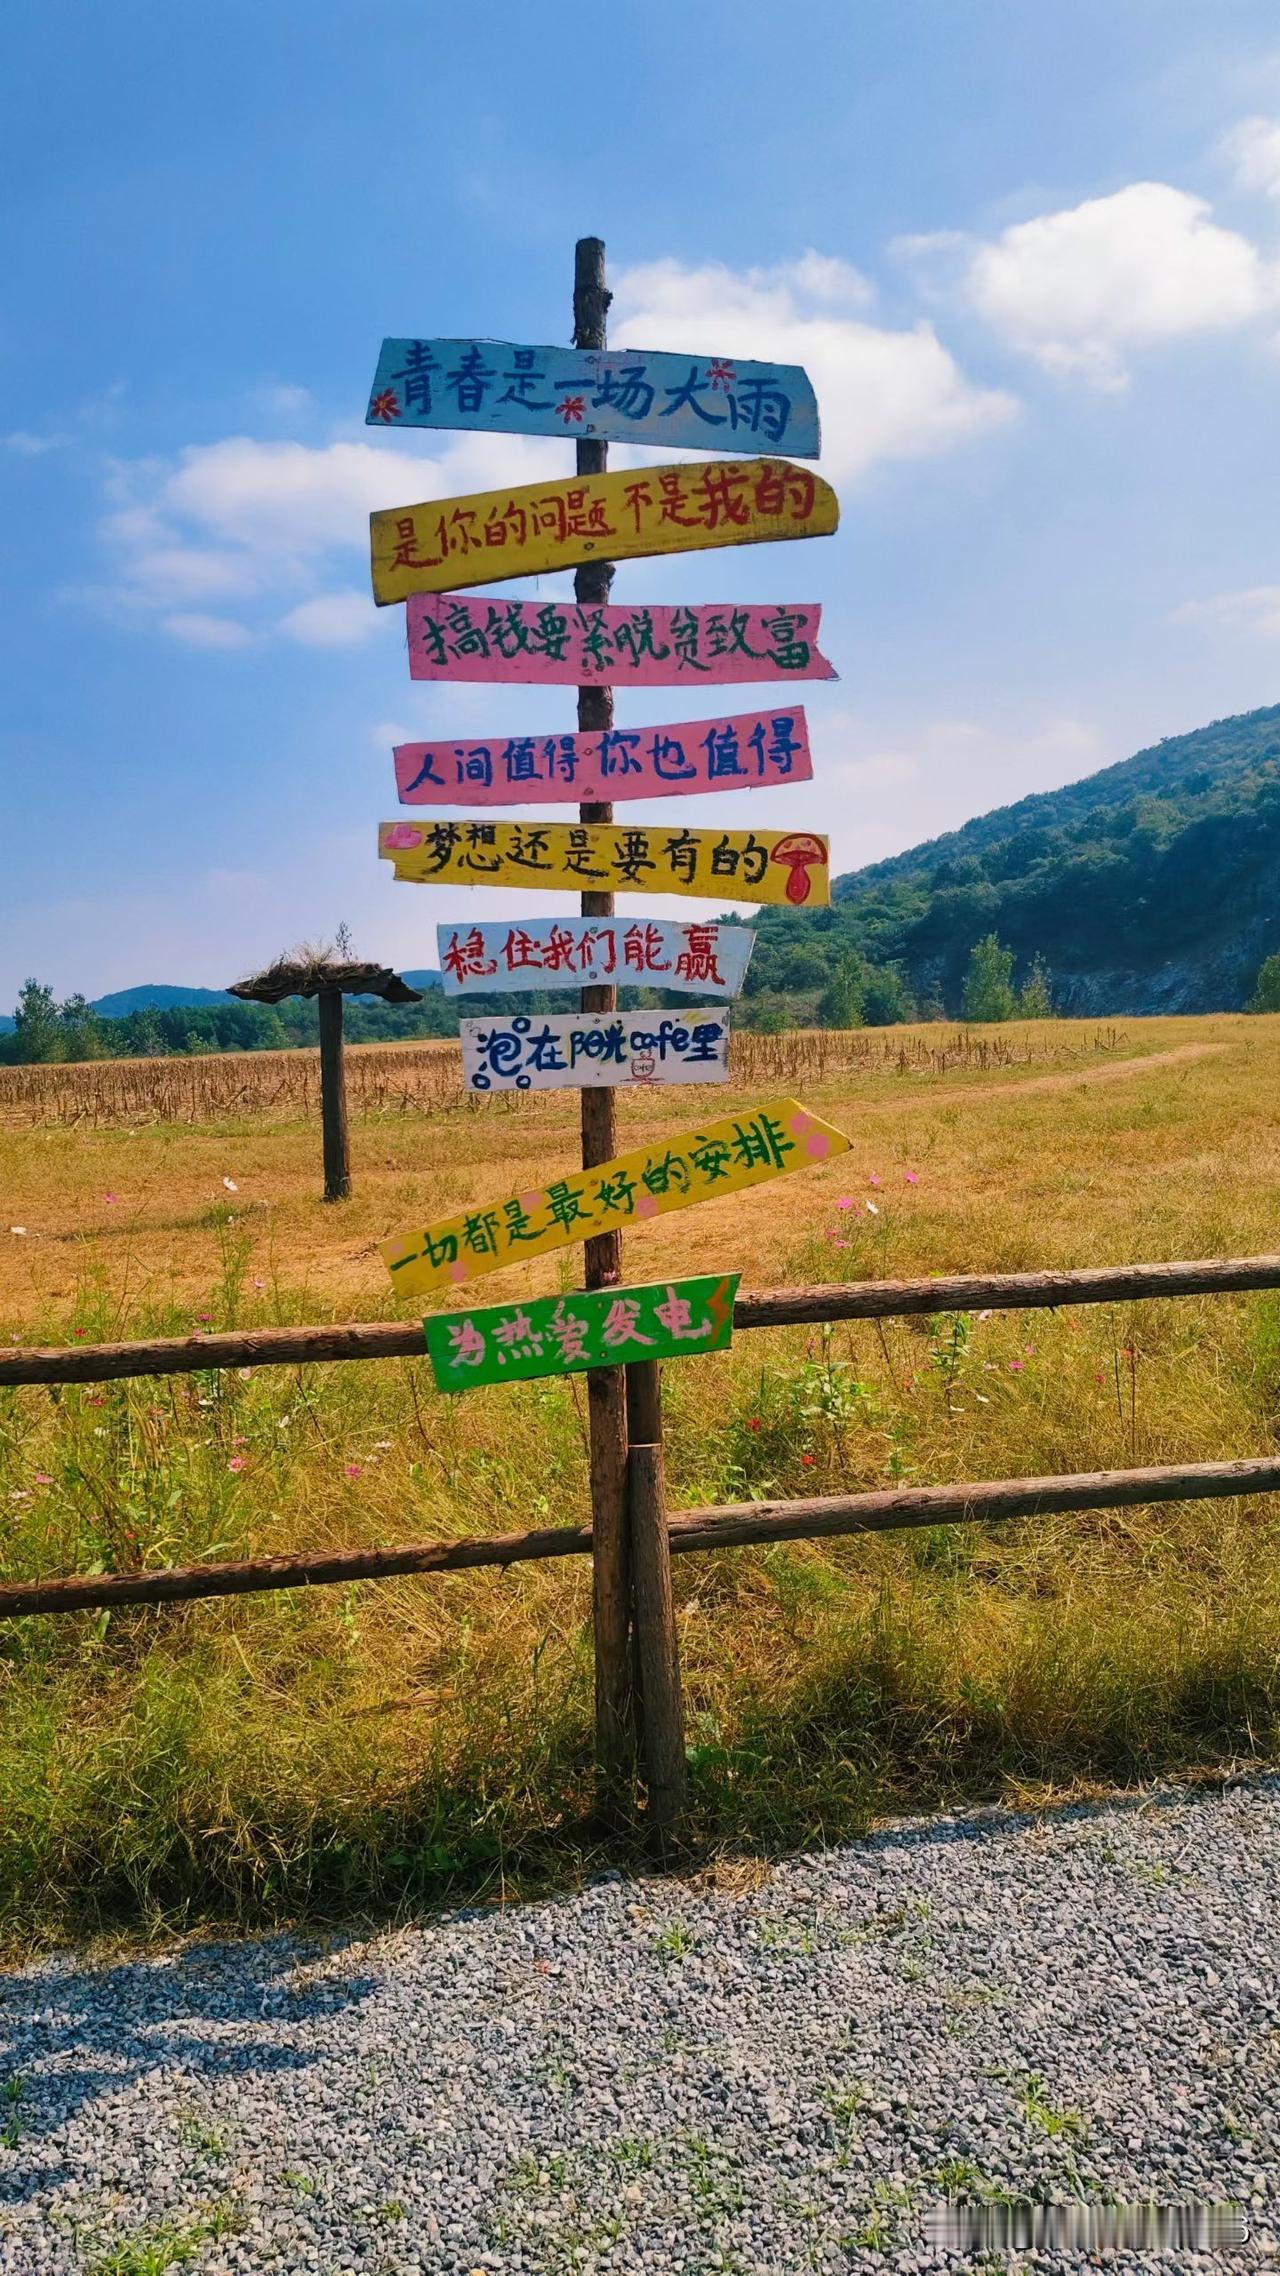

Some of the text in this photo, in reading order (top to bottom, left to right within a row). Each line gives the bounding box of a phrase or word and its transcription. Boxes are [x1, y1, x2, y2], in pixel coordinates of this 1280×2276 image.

[390, 341, 793, 443] 青春是一场大雨
[422, 602, 811, 671] 搞钱要紧脱贫致富
[424, 823, 769, 884] 梦想还是要有的
[442, 923, 727, 986] 稳住我们能赢
[389, 1113, 796, 1272] 一切都是最好的安排
[448, 1286, 712, 1369] 为热爱发电
